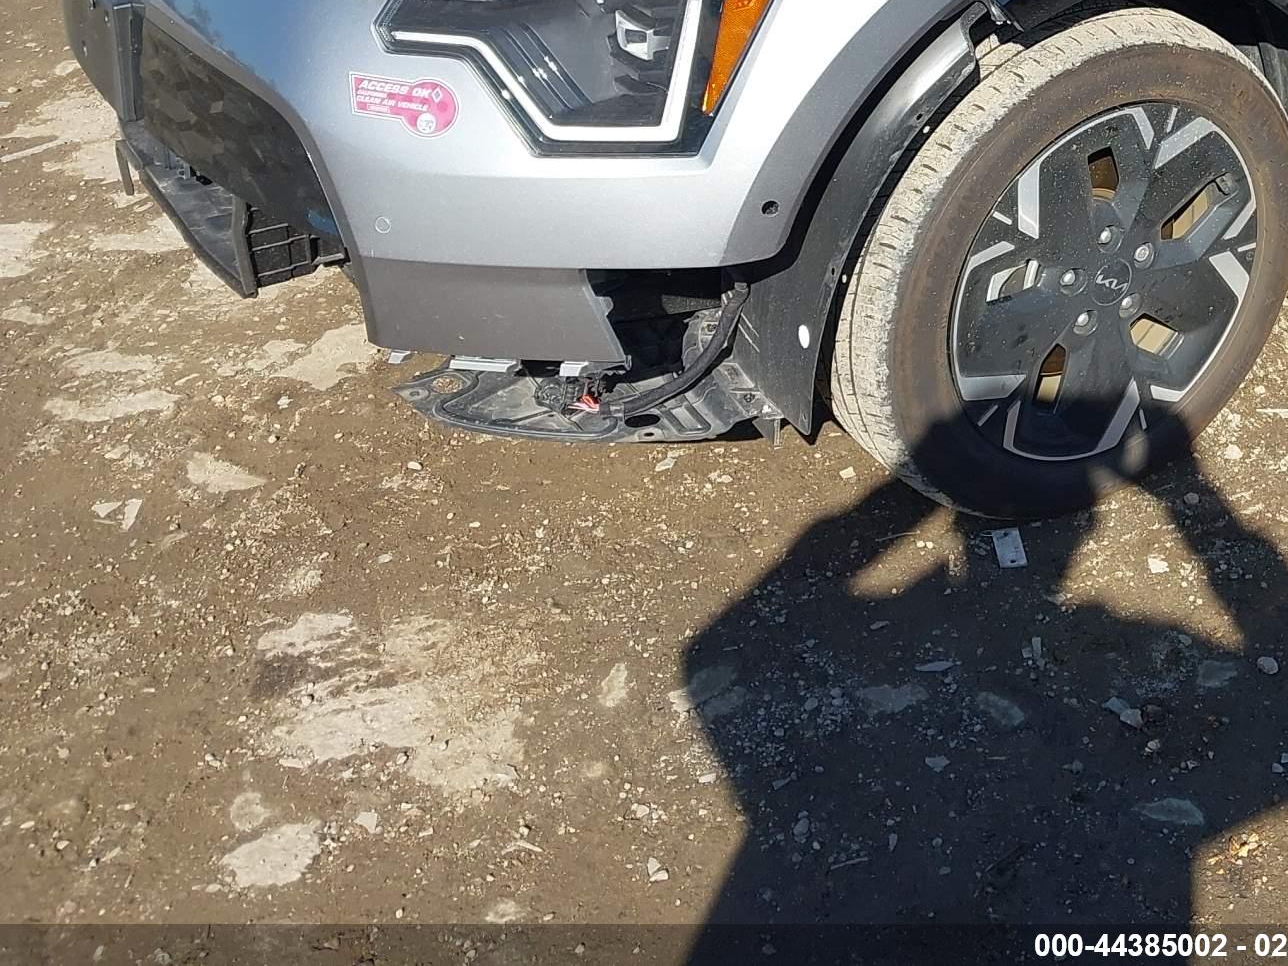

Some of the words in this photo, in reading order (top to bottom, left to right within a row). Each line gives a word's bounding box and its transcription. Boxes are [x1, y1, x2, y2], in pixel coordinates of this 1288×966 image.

[359, 80, 410, 95] ACCESS
[412, 87, 432, 98] OK
[357, 95, 381, 104] CLEAN
[382, 98, 397, 107] AIR
[397, 101, 429, 112] VEHICLE
